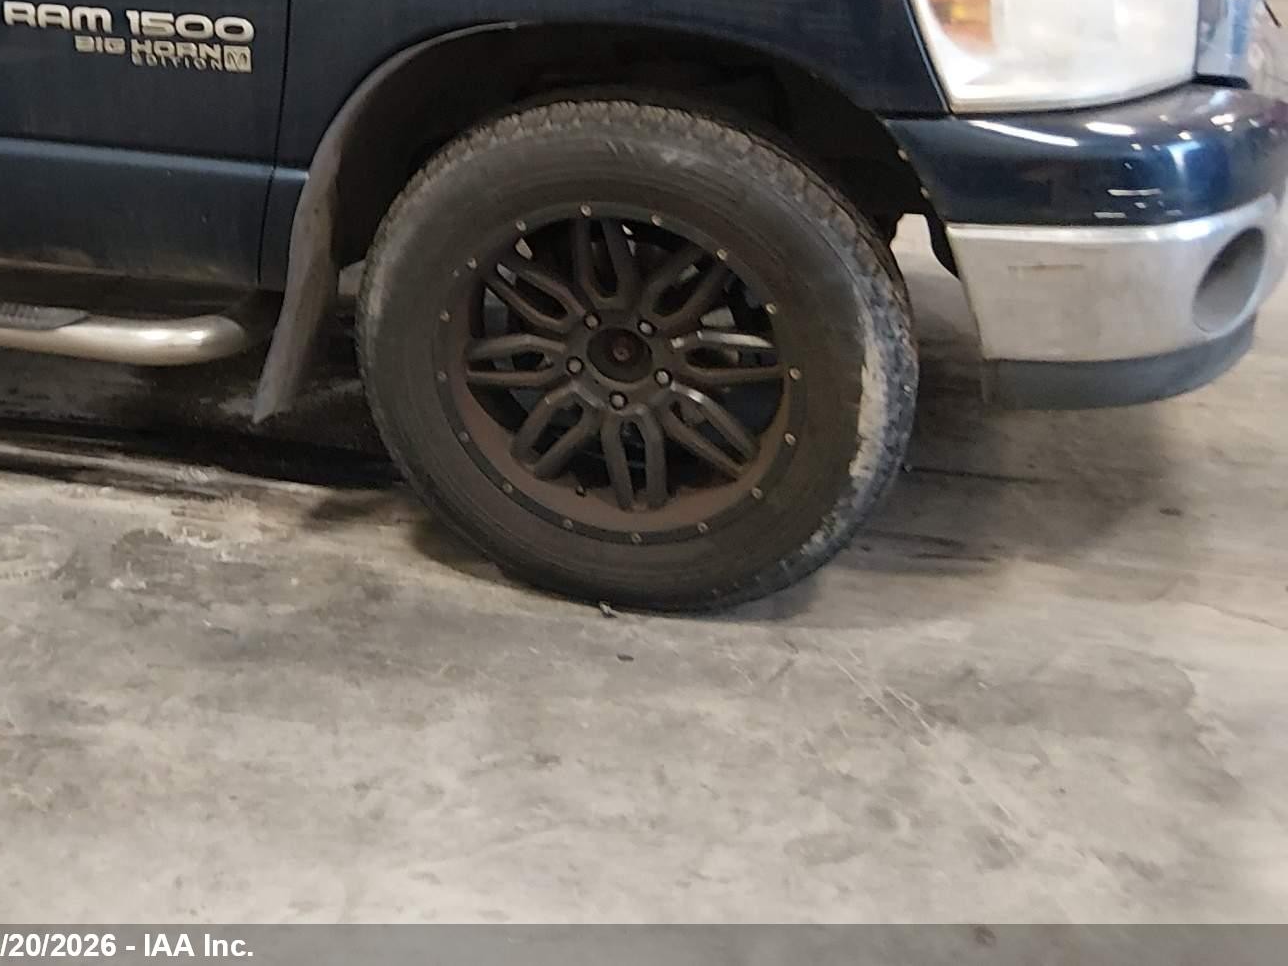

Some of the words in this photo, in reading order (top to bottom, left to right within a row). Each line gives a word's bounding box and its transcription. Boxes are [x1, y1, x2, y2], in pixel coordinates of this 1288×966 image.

[3, 0, 112, 34] RAM
[125, 9, 255, 43] 1500
[74, 35, 125, 55] BIG
[130, 38, 224, 60] HORN
